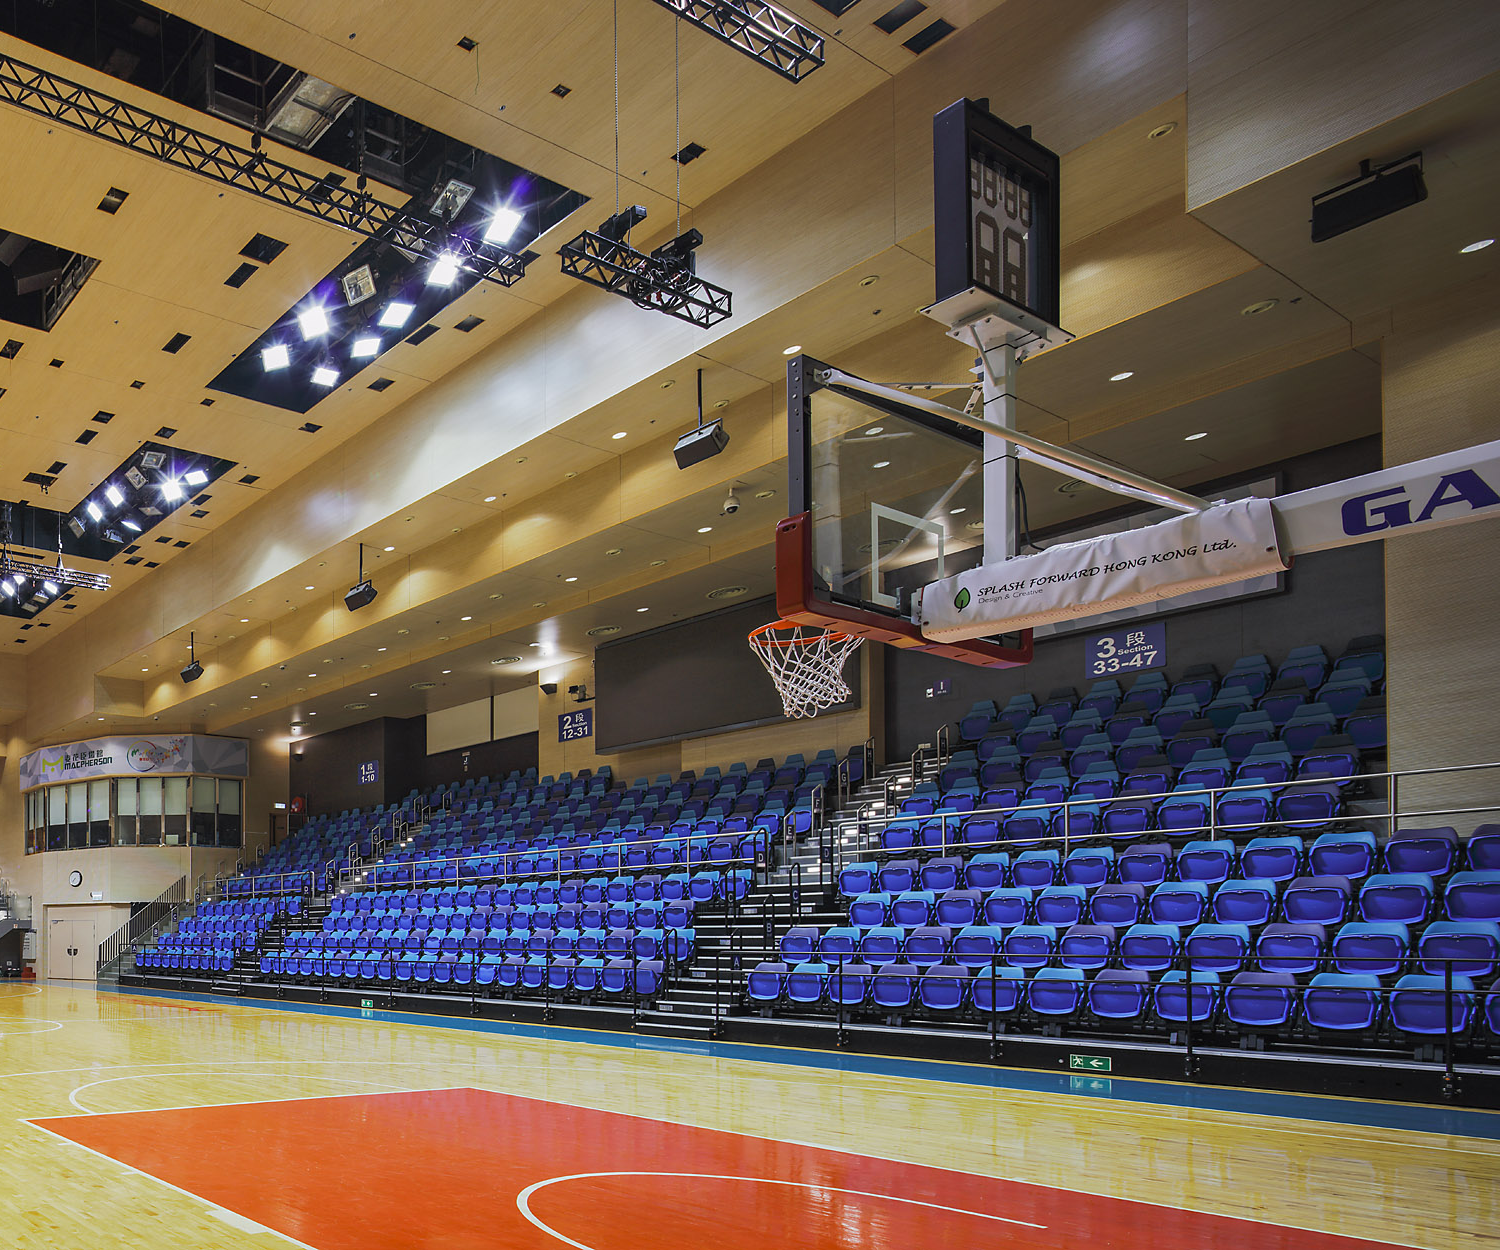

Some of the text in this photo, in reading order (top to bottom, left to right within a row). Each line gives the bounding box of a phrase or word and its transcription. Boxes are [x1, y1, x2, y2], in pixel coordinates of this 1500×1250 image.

[1341, 468, 1500, 536] GA
[977, 539, 1237, 597] SPLASH FORWARD HONG KONG Ltd.
[978, 595, 1003, 604] Design
[1012, 588, 1044, 598] Creative
[1096, 631, 1146, 658] 3 段
[1118, 644, 1153, 656] Section
[1093, 650, 1158, 674] 33-47
[564, 716, 572, 730] 2
[562, 726, 588, 739] 12-31
[65, 756, 112, 770] MACPHERSON
[361, 764, 365, 776] 1
[361, 774, 375, 783] 1-10
[841, 773, 847, 782] G
[788, 826, 792, 835] E
[758, 853, 764, 861] D
[728, 893, 733, 902] C
[793, 890, 798, 900] C
[669, 956, 675, 965] A
[734, 957, 739, 967] A
